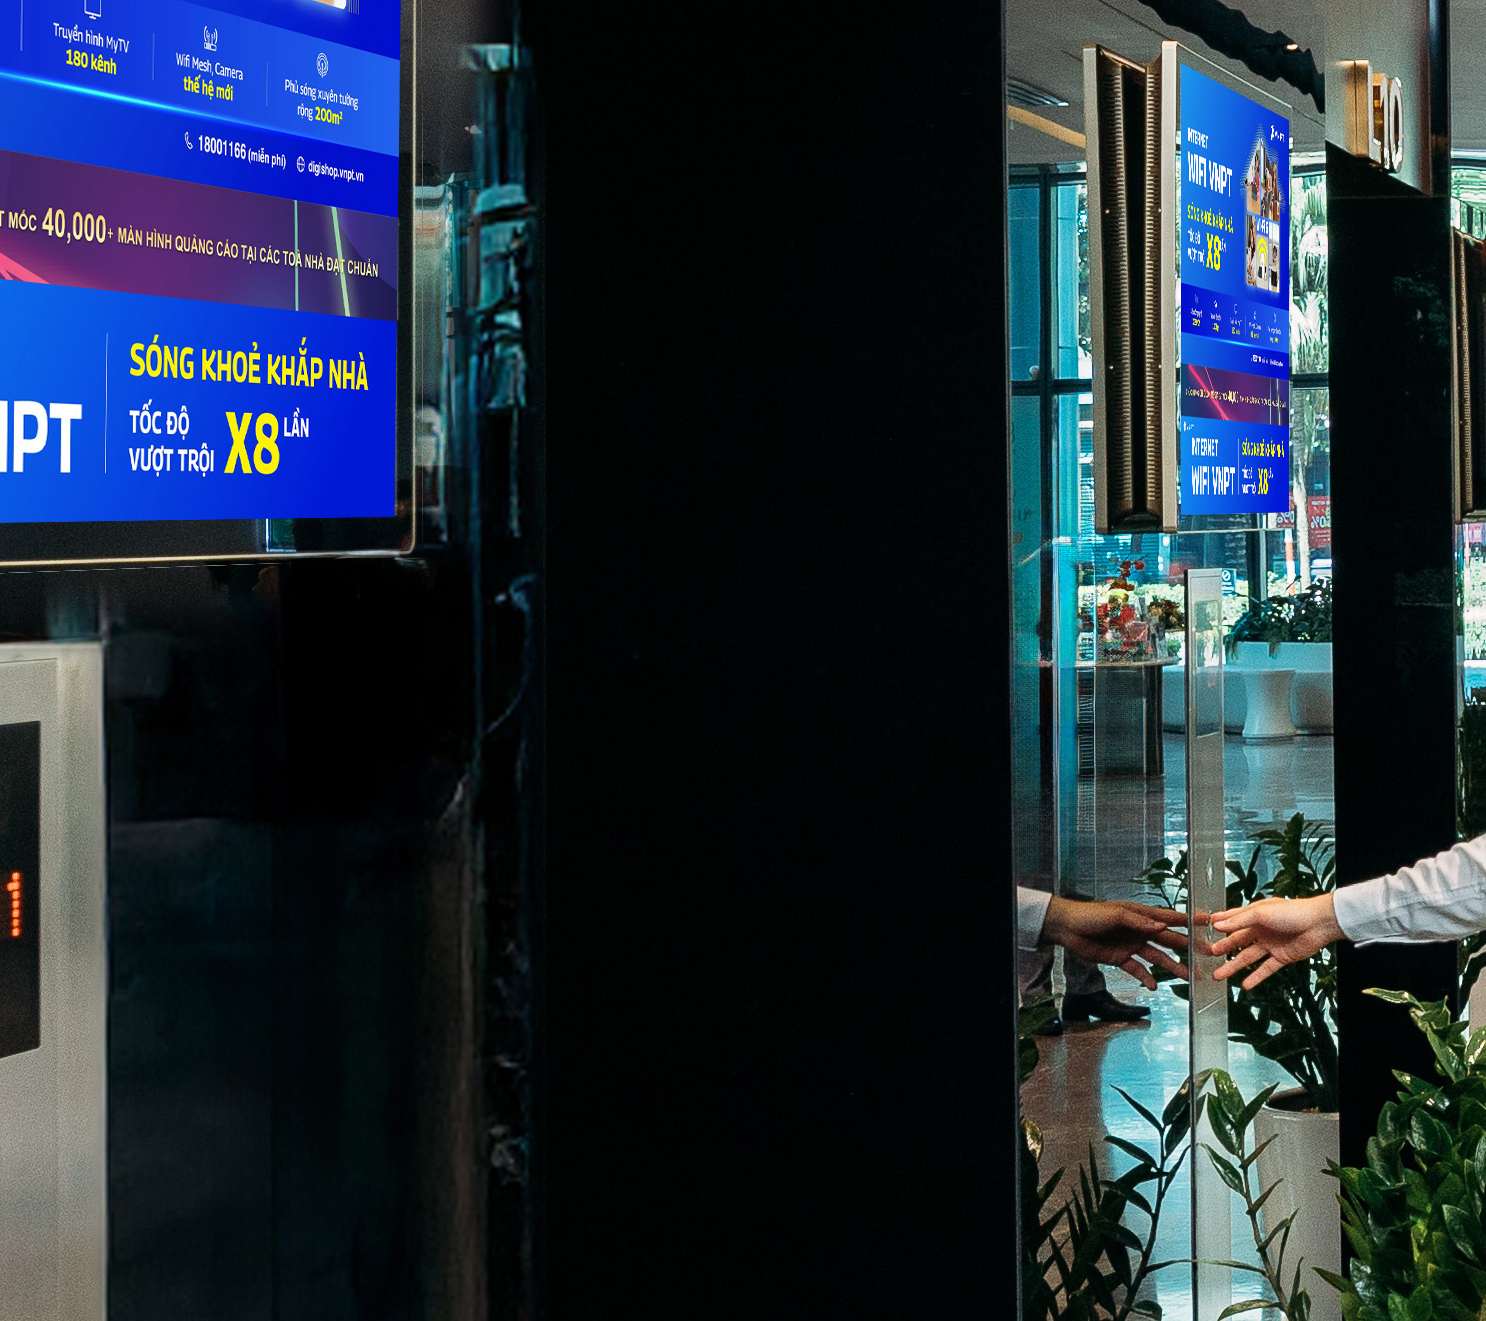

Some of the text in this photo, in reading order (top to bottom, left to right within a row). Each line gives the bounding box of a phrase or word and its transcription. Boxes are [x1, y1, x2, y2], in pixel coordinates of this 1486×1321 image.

[53, 22, 129, 54] Truyền hình MyTV
[65, 49, 117, 75] 180 kênh
[175, 52, 244, 81] Wifi Mesh, Camera
[183, 75, 234, 101] thế hệ mới
[300, 83, 316, 101] sóng
[318, 89, 337, 104] xuyên
[297, 103, 313, 121] rộng
[198, 135, 287, 170] 18001166 (miễn phí)
[308, 160, 364, 182] digishop.vnpt.vn
[1187, 151, 1232, 198] WIFI VNPT
[8, 207, 38, 233] MỐC
[117, 224, 143, 246] MÀN
[146, 228, 172, 250] HÌNH
[216, 239, 239, 258] CÁO
[241, 245, 257, 264] TẠI
[259, 245, 280, 264] CÁC
[283, 249, 302, 268] TOÀ
[305, 252, 324, 270] NHÀ
[326, 257, 345, 276] ĐẠT
[1206, 232, 1220, 271] X8
[130, 334, 369, 391] SÓNG KHOẺ KHẮP NHÀ
[129, 399, 190, 440] TỐC ĐỘ
[284, 407, 309, 437] LẦN
[224, 411, 280, 475] X8
[129, 443, 214, 477] VƯỢT TRỘI
[1192, 465, 1209, 495] WIFI
[1212, 467, 1235, 495] VNPT
[1258, 468, 1268, 495] X8
